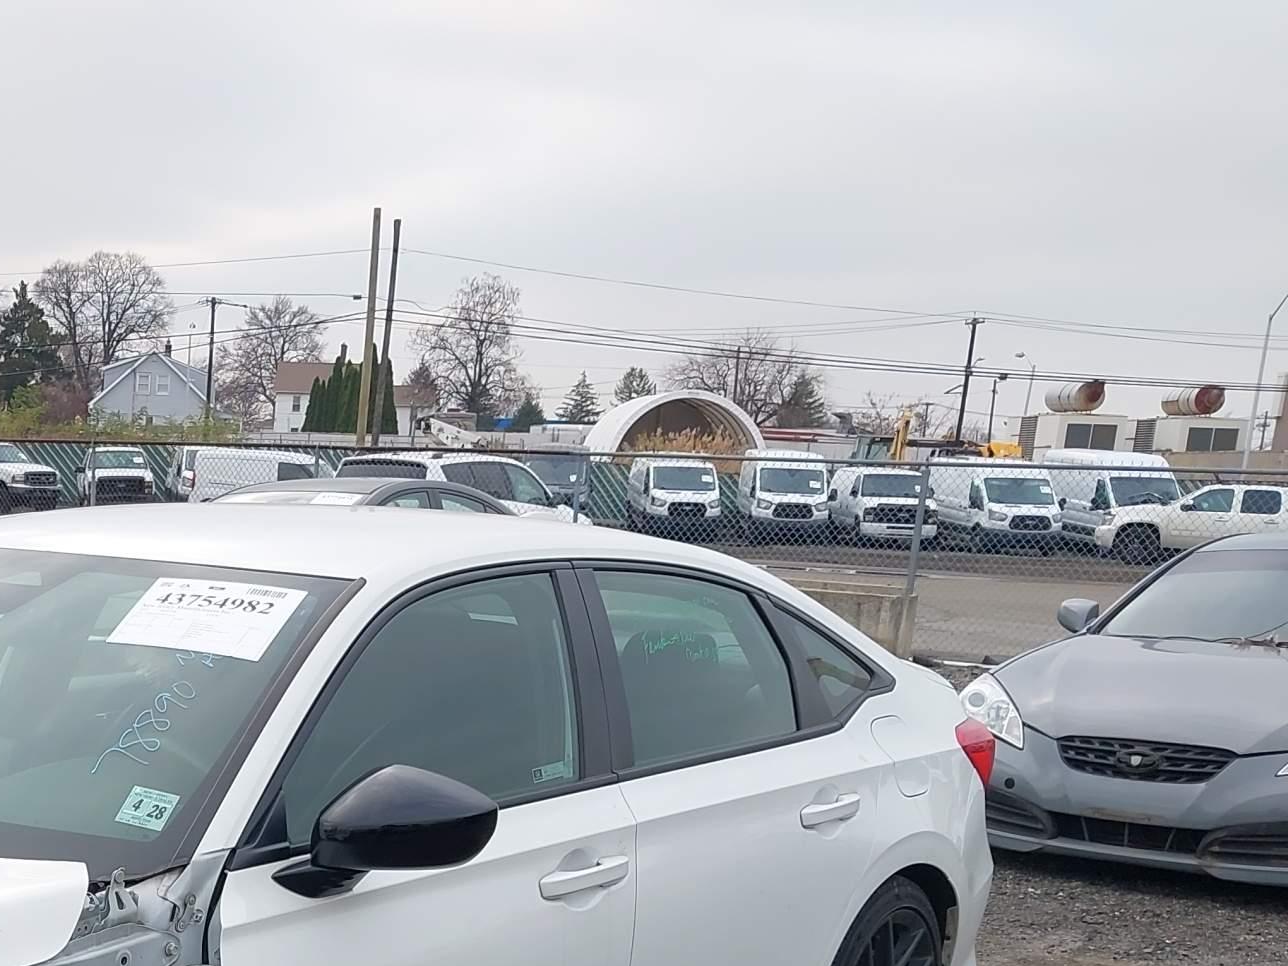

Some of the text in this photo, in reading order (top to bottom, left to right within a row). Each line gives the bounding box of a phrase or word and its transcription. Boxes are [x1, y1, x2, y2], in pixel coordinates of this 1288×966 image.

[156, 592, 275, 615] 43754982
[90, 680, 197, 775] 78890
[132, 798, 145, 812] 4
[146, 804, 167, 821] 28
